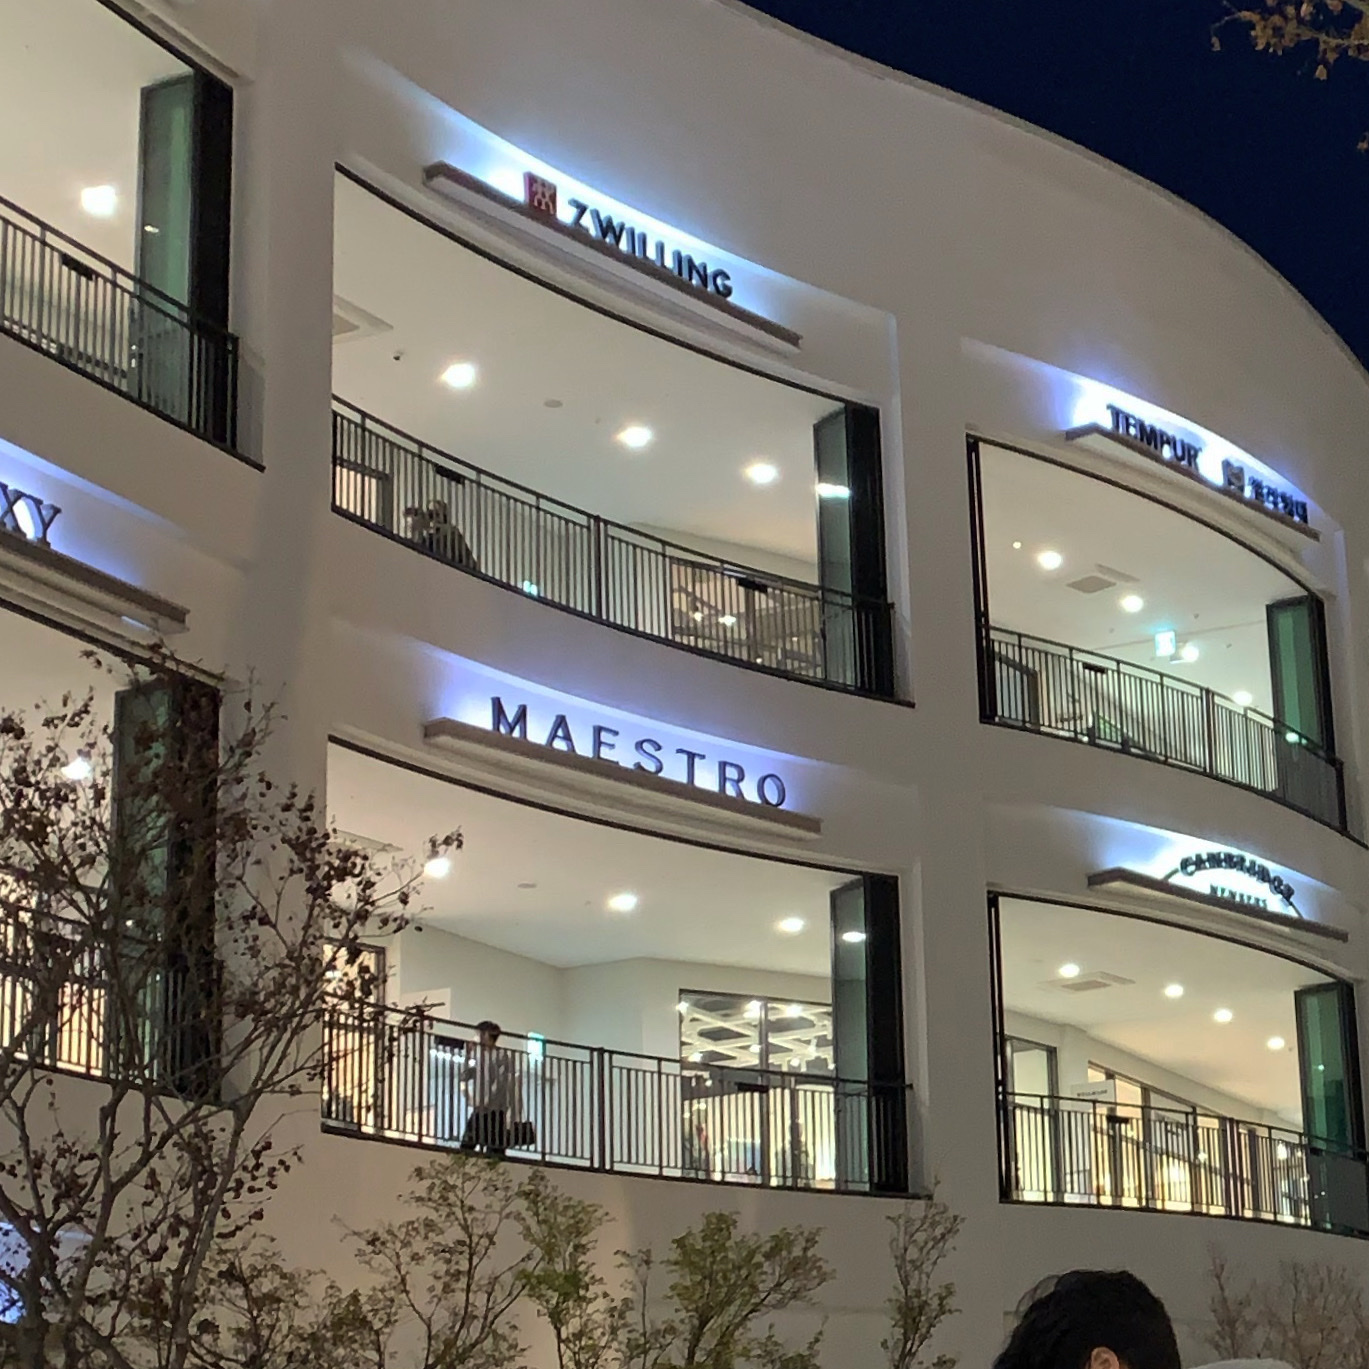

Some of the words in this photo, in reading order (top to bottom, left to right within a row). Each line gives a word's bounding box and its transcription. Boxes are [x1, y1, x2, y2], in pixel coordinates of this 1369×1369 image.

[568, 198, 733, 300] ZWILLING
[1107, 403, 1201, 473] TEMPUR
[490, 696, 787, 808] MAESTRO
